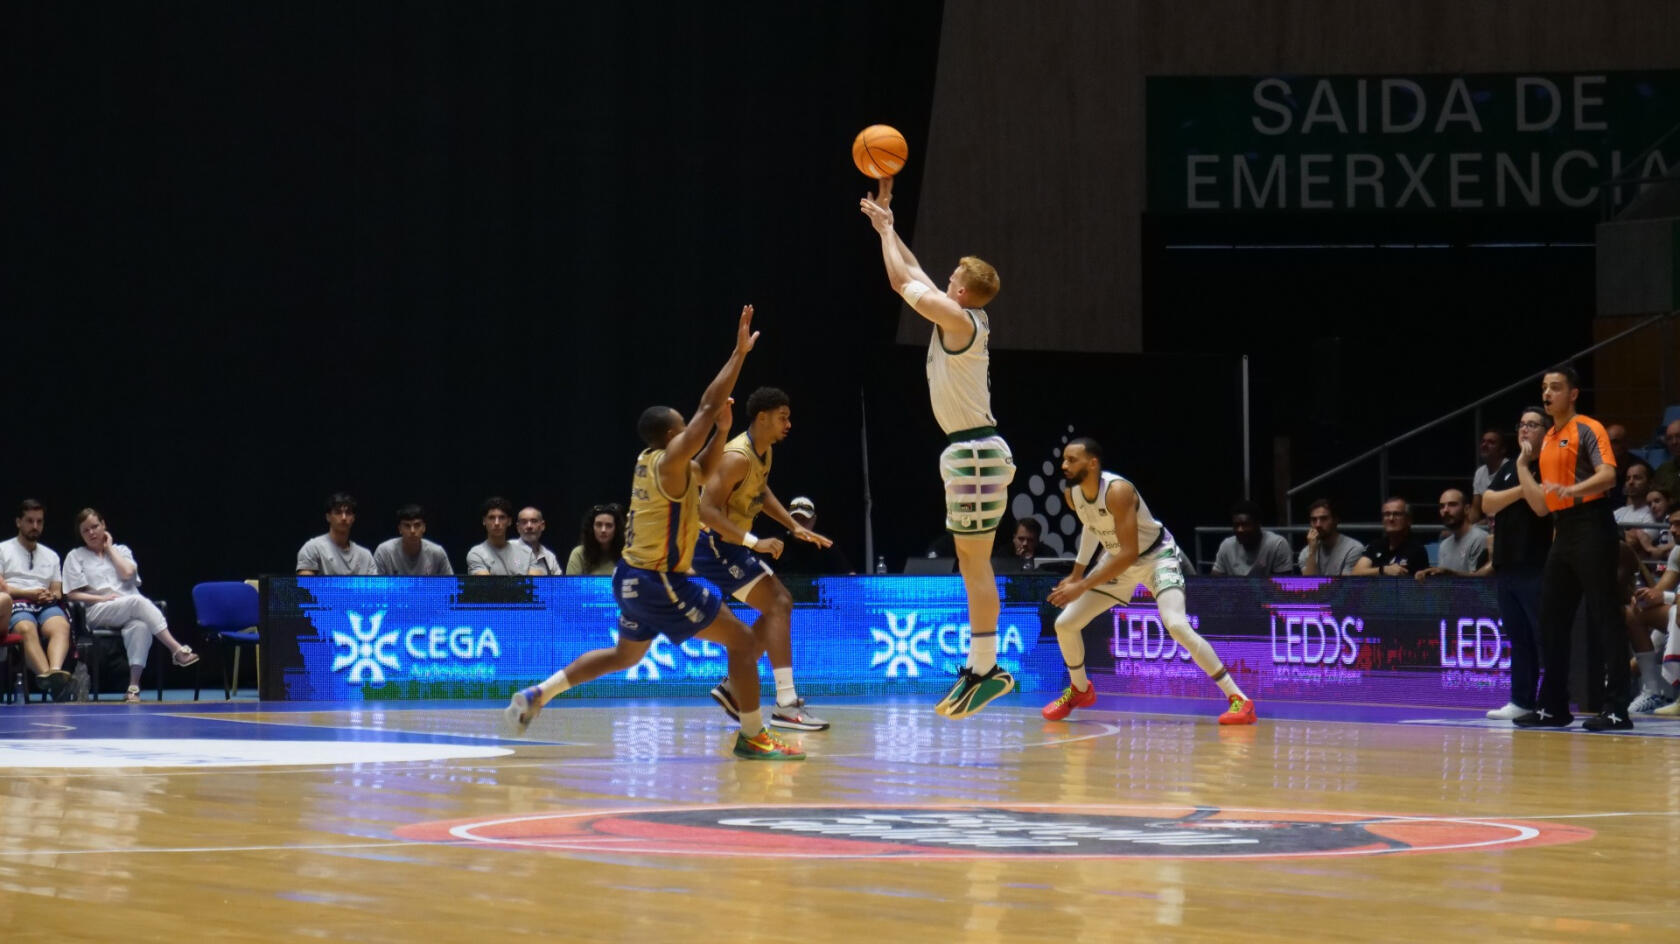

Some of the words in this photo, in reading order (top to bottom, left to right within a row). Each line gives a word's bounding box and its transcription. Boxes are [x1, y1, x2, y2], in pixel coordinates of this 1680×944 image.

[1251, 77, 1484, 135] SAIDA
[1516, 75, 1609, 132] DE
[405, 626, 500, 658] CEGA
[938, 623, 1025, 654] CEA
